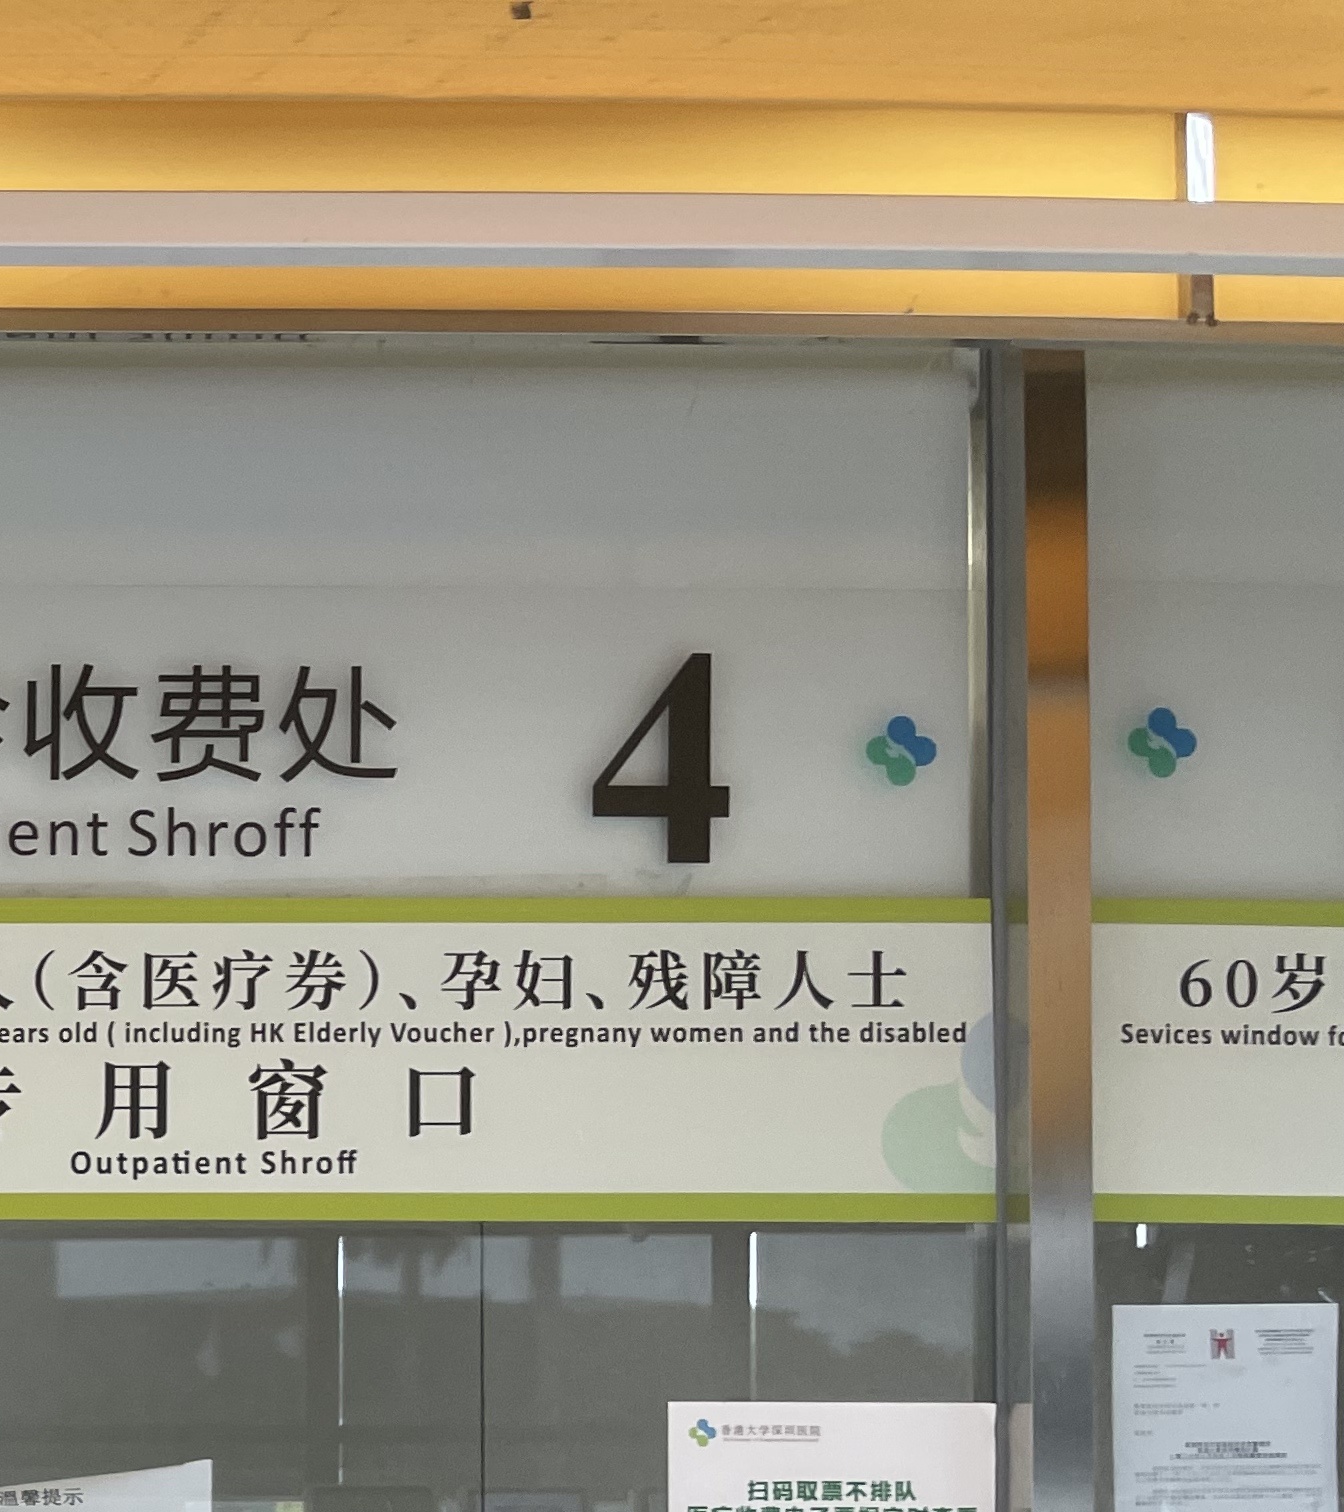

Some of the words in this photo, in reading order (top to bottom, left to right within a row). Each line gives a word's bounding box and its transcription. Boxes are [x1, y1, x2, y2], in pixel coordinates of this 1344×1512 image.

[592, 652, 730, 864] 4
[128, 807, 321, 858] Shroff
[1179, 953, 1327, 1014] 60岁
[59, 1022, 97, 1043] old
[251, 1023, 284, 1042] HK
[295, 1022, 381, 1047] Elderly
[651, 1028, 743, 1043] women
[753, 1022, 798, 1043] and
[809, 1022, 850, 1043] the
[860, 1022, 966, 1043] disabled
[1121, 1023, 1211, 1044] Sevices
[1221, 1025, 1319, 1045] window
[71, 1150, 246, 1180] Outpatient
[262, 1150, 357, 1175] Shroff
[747, 1480, 916, 1502] 扫码取票不排队
